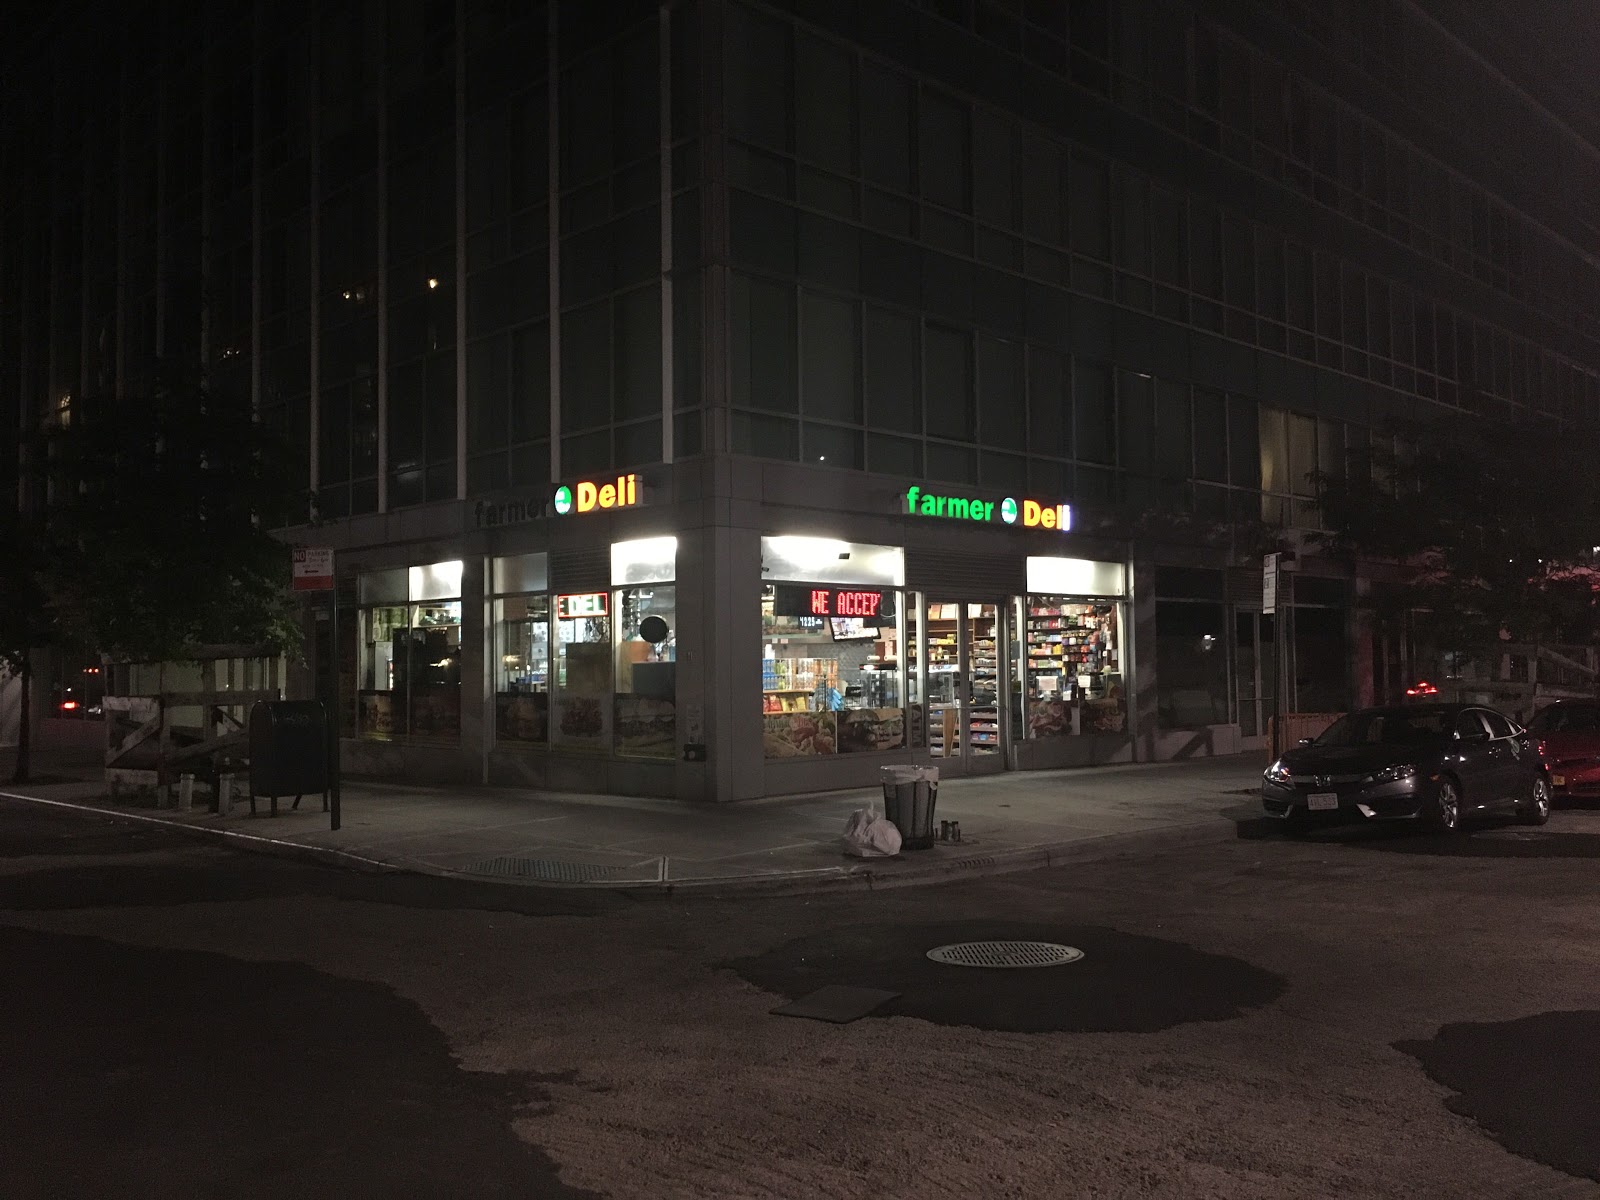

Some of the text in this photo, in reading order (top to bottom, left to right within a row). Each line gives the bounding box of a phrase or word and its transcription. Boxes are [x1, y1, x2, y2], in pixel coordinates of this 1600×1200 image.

[577, 473, 636, 513] Deli
[906, 486, 1071, 531] farmer Deli
[294, 551, 305, 561] NO
[811, 590, 880, 616] WE ACCEP
